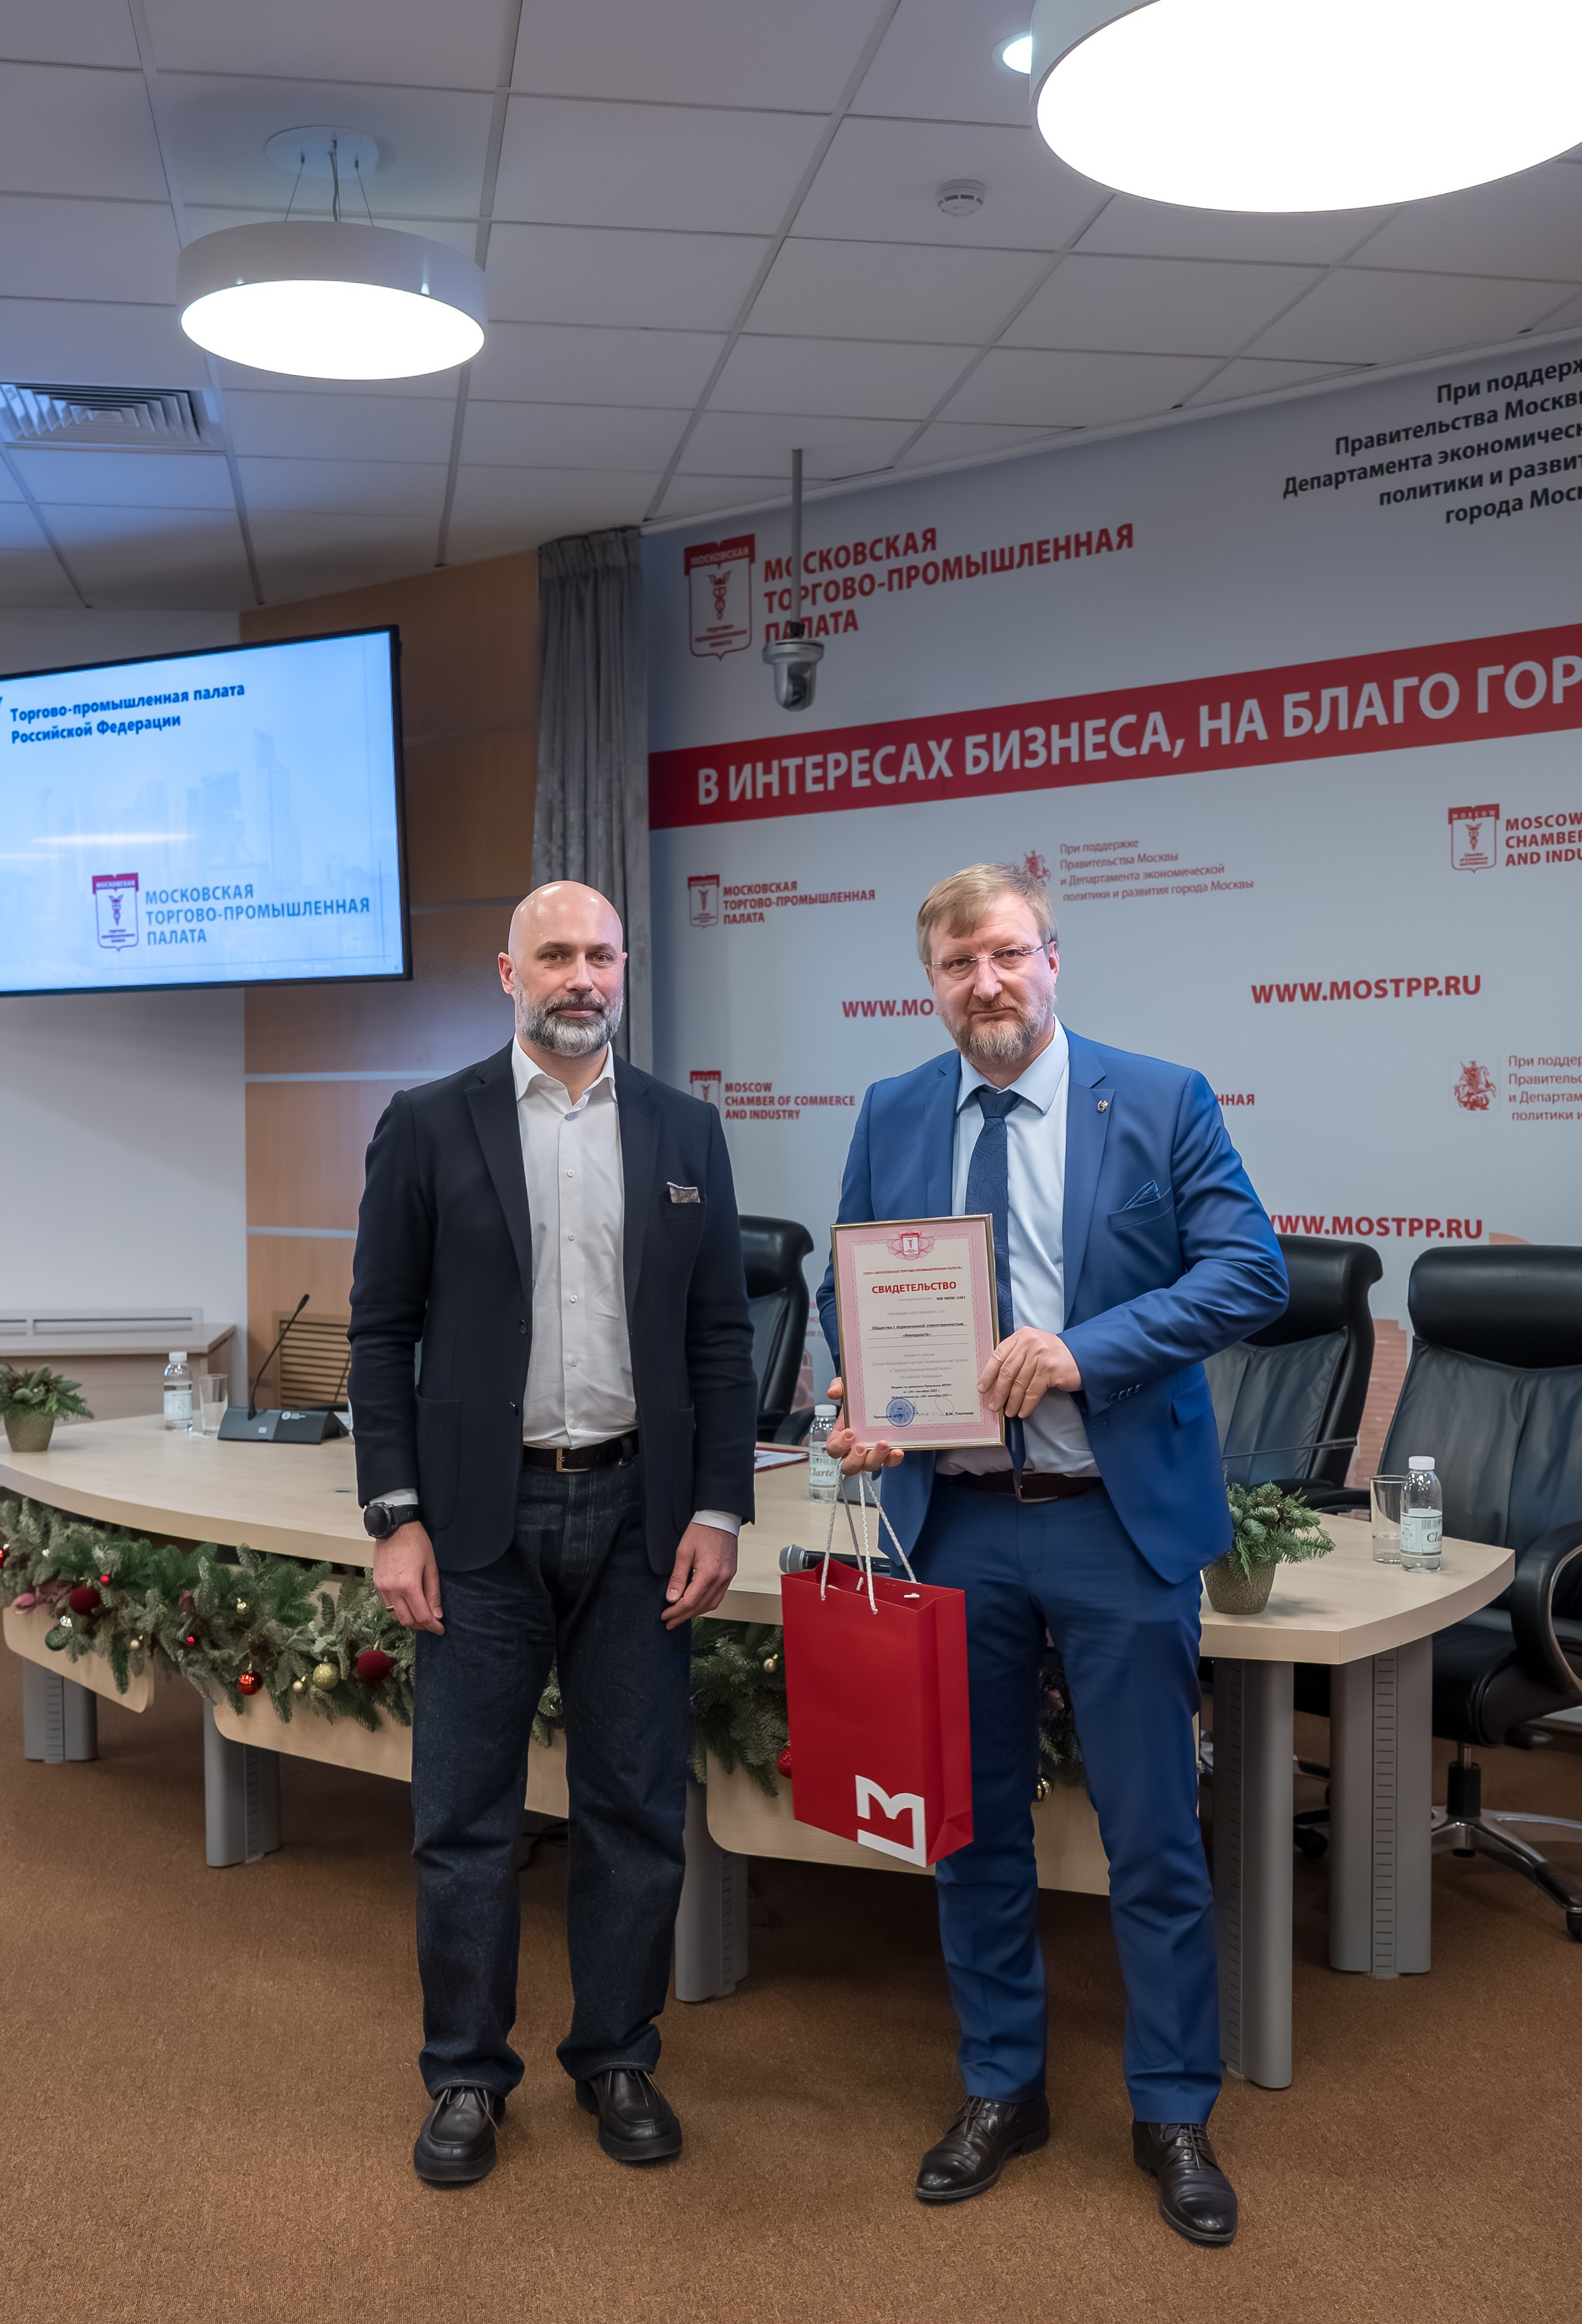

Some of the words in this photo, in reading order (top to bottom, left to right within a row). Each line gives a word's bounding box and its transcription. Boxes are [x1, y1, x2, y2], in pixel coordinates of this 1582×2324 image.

[1436, 381, 1481, 405] При
[1335, 408, 1499, 457] Правительства
[1504, 390, 1582, 420] Москв
[1282, 453, 1432, 499] Департамента
[1379, 473, 1483, 506] политики
[1490, 470, 1502, 485] и
[1445, 496, 1523, 525] города
[10, 691, 189, 724] Торгово-промышленная
[193, 684, 245, 700] палата
[11, 722, 93, 744] Российской
[97, 715, 181, 735] Федерации
[698, 768, 719, 805] В
[729, 738, 954, 802] ИНТЕРЕСАХ
[965, 711, 1185, 776] БИЗНЕСА,
[1199, 699, 1269, 748] НА
[1283, 672, 1460, 739] БЛАГО
[1477, 655, 1582, 714] ГОР
[1505, 812, 1582, 831] MOSCOW
[1060, 844, 1080, 855] При
[1083, 840, 1139, 853] поддержке
[1060, 855, 1135, 870] Правительства
[1137, 852, 1179, 863] Москвы
[1505, 852, 1541, 867] AND
[1068, 871, 1140, 886] Департамента
[1143, 863, 1225, 880] экономической
[145, 884, 253, 904] МОСКОВСКАЯ
[724, 881, 797, 896] МОСКОВСКАЯ
[1063, 891, 1110, 902] политики
[1122, 887, 1169, 899] развития
[1172, 883, 1208, 895] города
[1211, 880, 1254, 891] Москвы
[724, 889, 875, 910] ТОРГОВО-ПРОМЫШЛЕННАЯ
[146, 897, 370, 925] ТОРГОВО-ПРОМЫШЛЕННАЯ
[724, 912, 764, 924] ПАЛАТА
[147, 929, 206, 946] ПАЛАТА
[1251, 975, 1481, 1004] WWW.MOSTPP.RU
[1508, 1056, 1534, 1069] При
[725, 1082, 772, 1092] MOSCOW
[725, 1096, 775, 1106] CHAMBER
[778, 1096, 792, 1106] OF
[794, 1096, 855, 1106] COMMERCE
[1508, 1095, 1516, 1103] и
[725, 1109, 747, 1119] AND
[750, 1109, 800, 1119] INDUSTRY
[1512, 1111, 1573, 1121] политики
[871, 1281, 957, 1294] СВИДЕТЕЛЬСТВО
